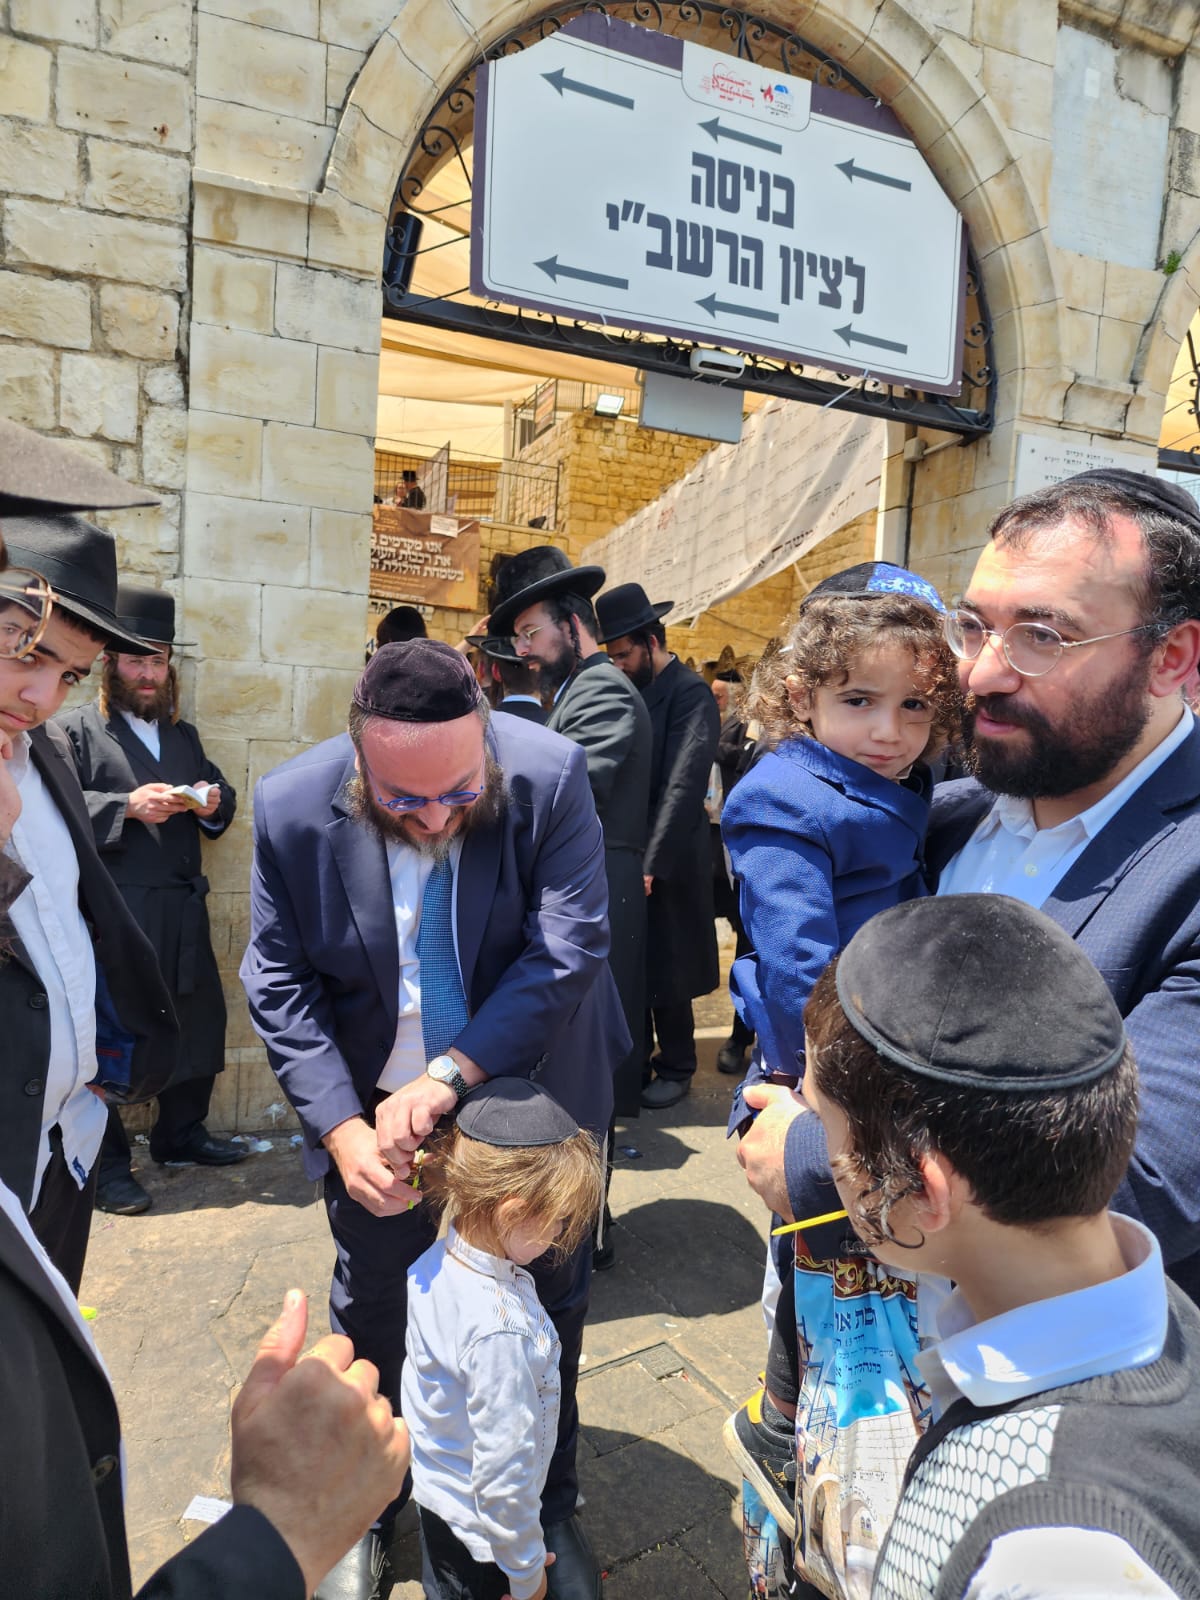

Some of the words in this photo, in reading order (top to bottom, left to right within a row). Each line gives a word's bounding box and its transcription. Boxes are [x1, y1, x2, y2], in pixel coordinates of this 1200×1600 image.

[692, 152, 795, 229] כניסה
[606, 200, 763, 290] הרשב"י
[780, 245, 866, 314] לציון
[379, 534, 423, 552] מקדמים
[425, 541, 442, 554] אנו
[381, 558, 421, 575] הילולת
[433, 554, 452, 567] את
[422, 566, 464, 581] בשמחת
